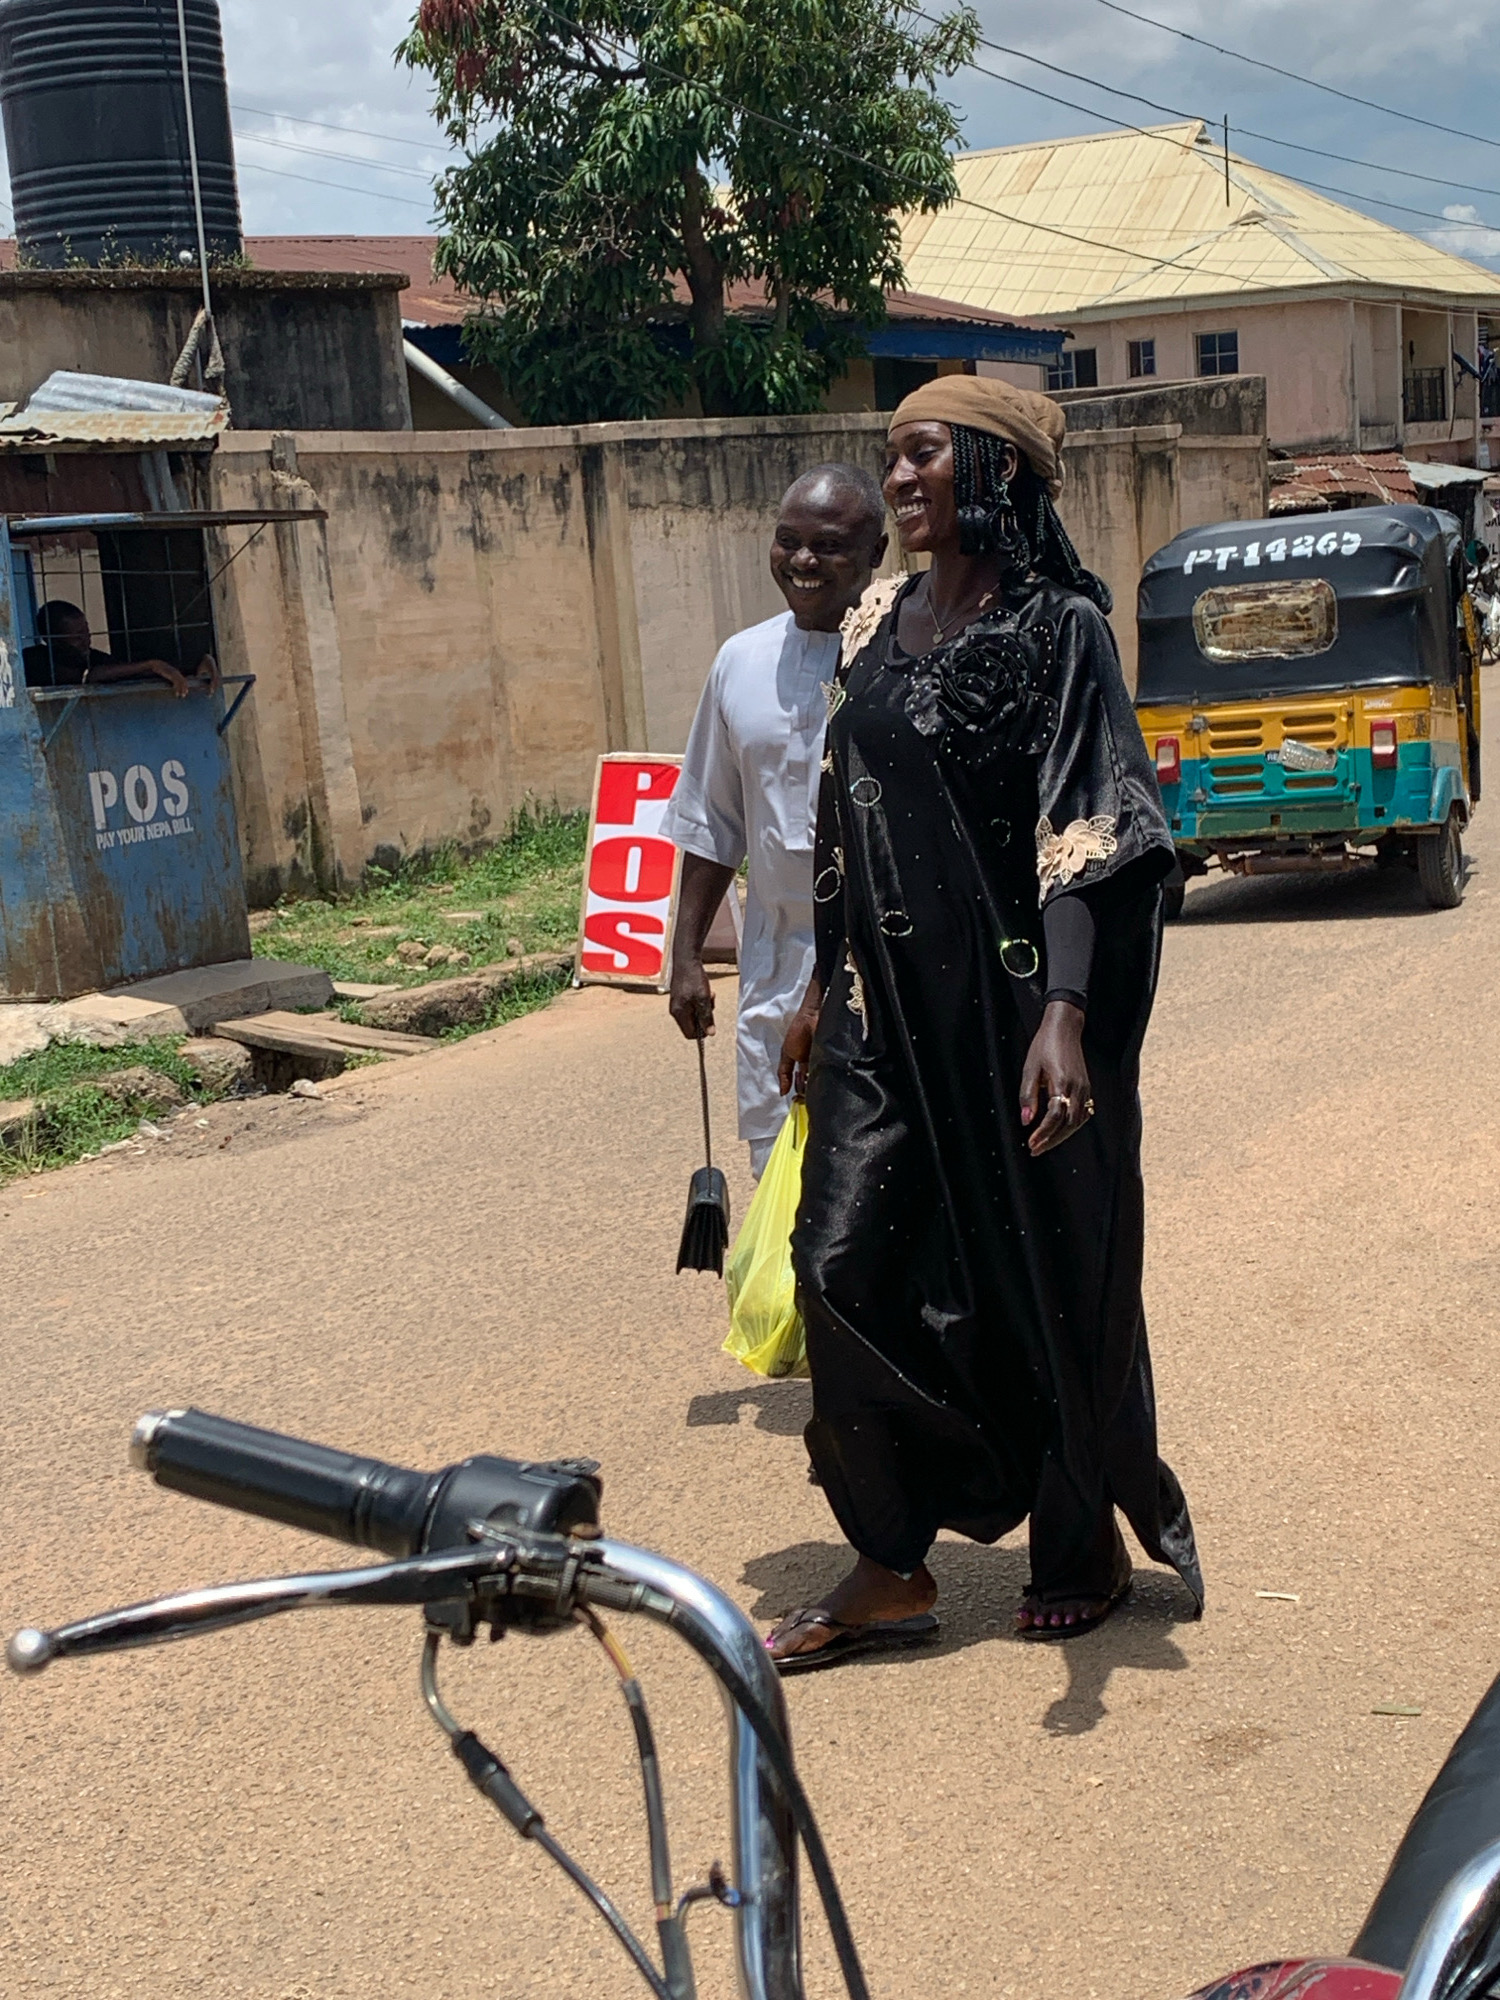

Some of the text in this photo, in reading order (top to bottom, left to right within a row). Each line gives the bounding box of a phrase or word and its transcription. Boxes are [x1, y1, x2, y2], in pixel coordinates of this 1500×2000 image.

[88, 759, 189, 830] POS
[96, 831, 115, 849] PAY
[117, 826, 145, 845] YOUR
[146, 821, 172, 840] NEPA
[581, 761, 682, 977] POS
